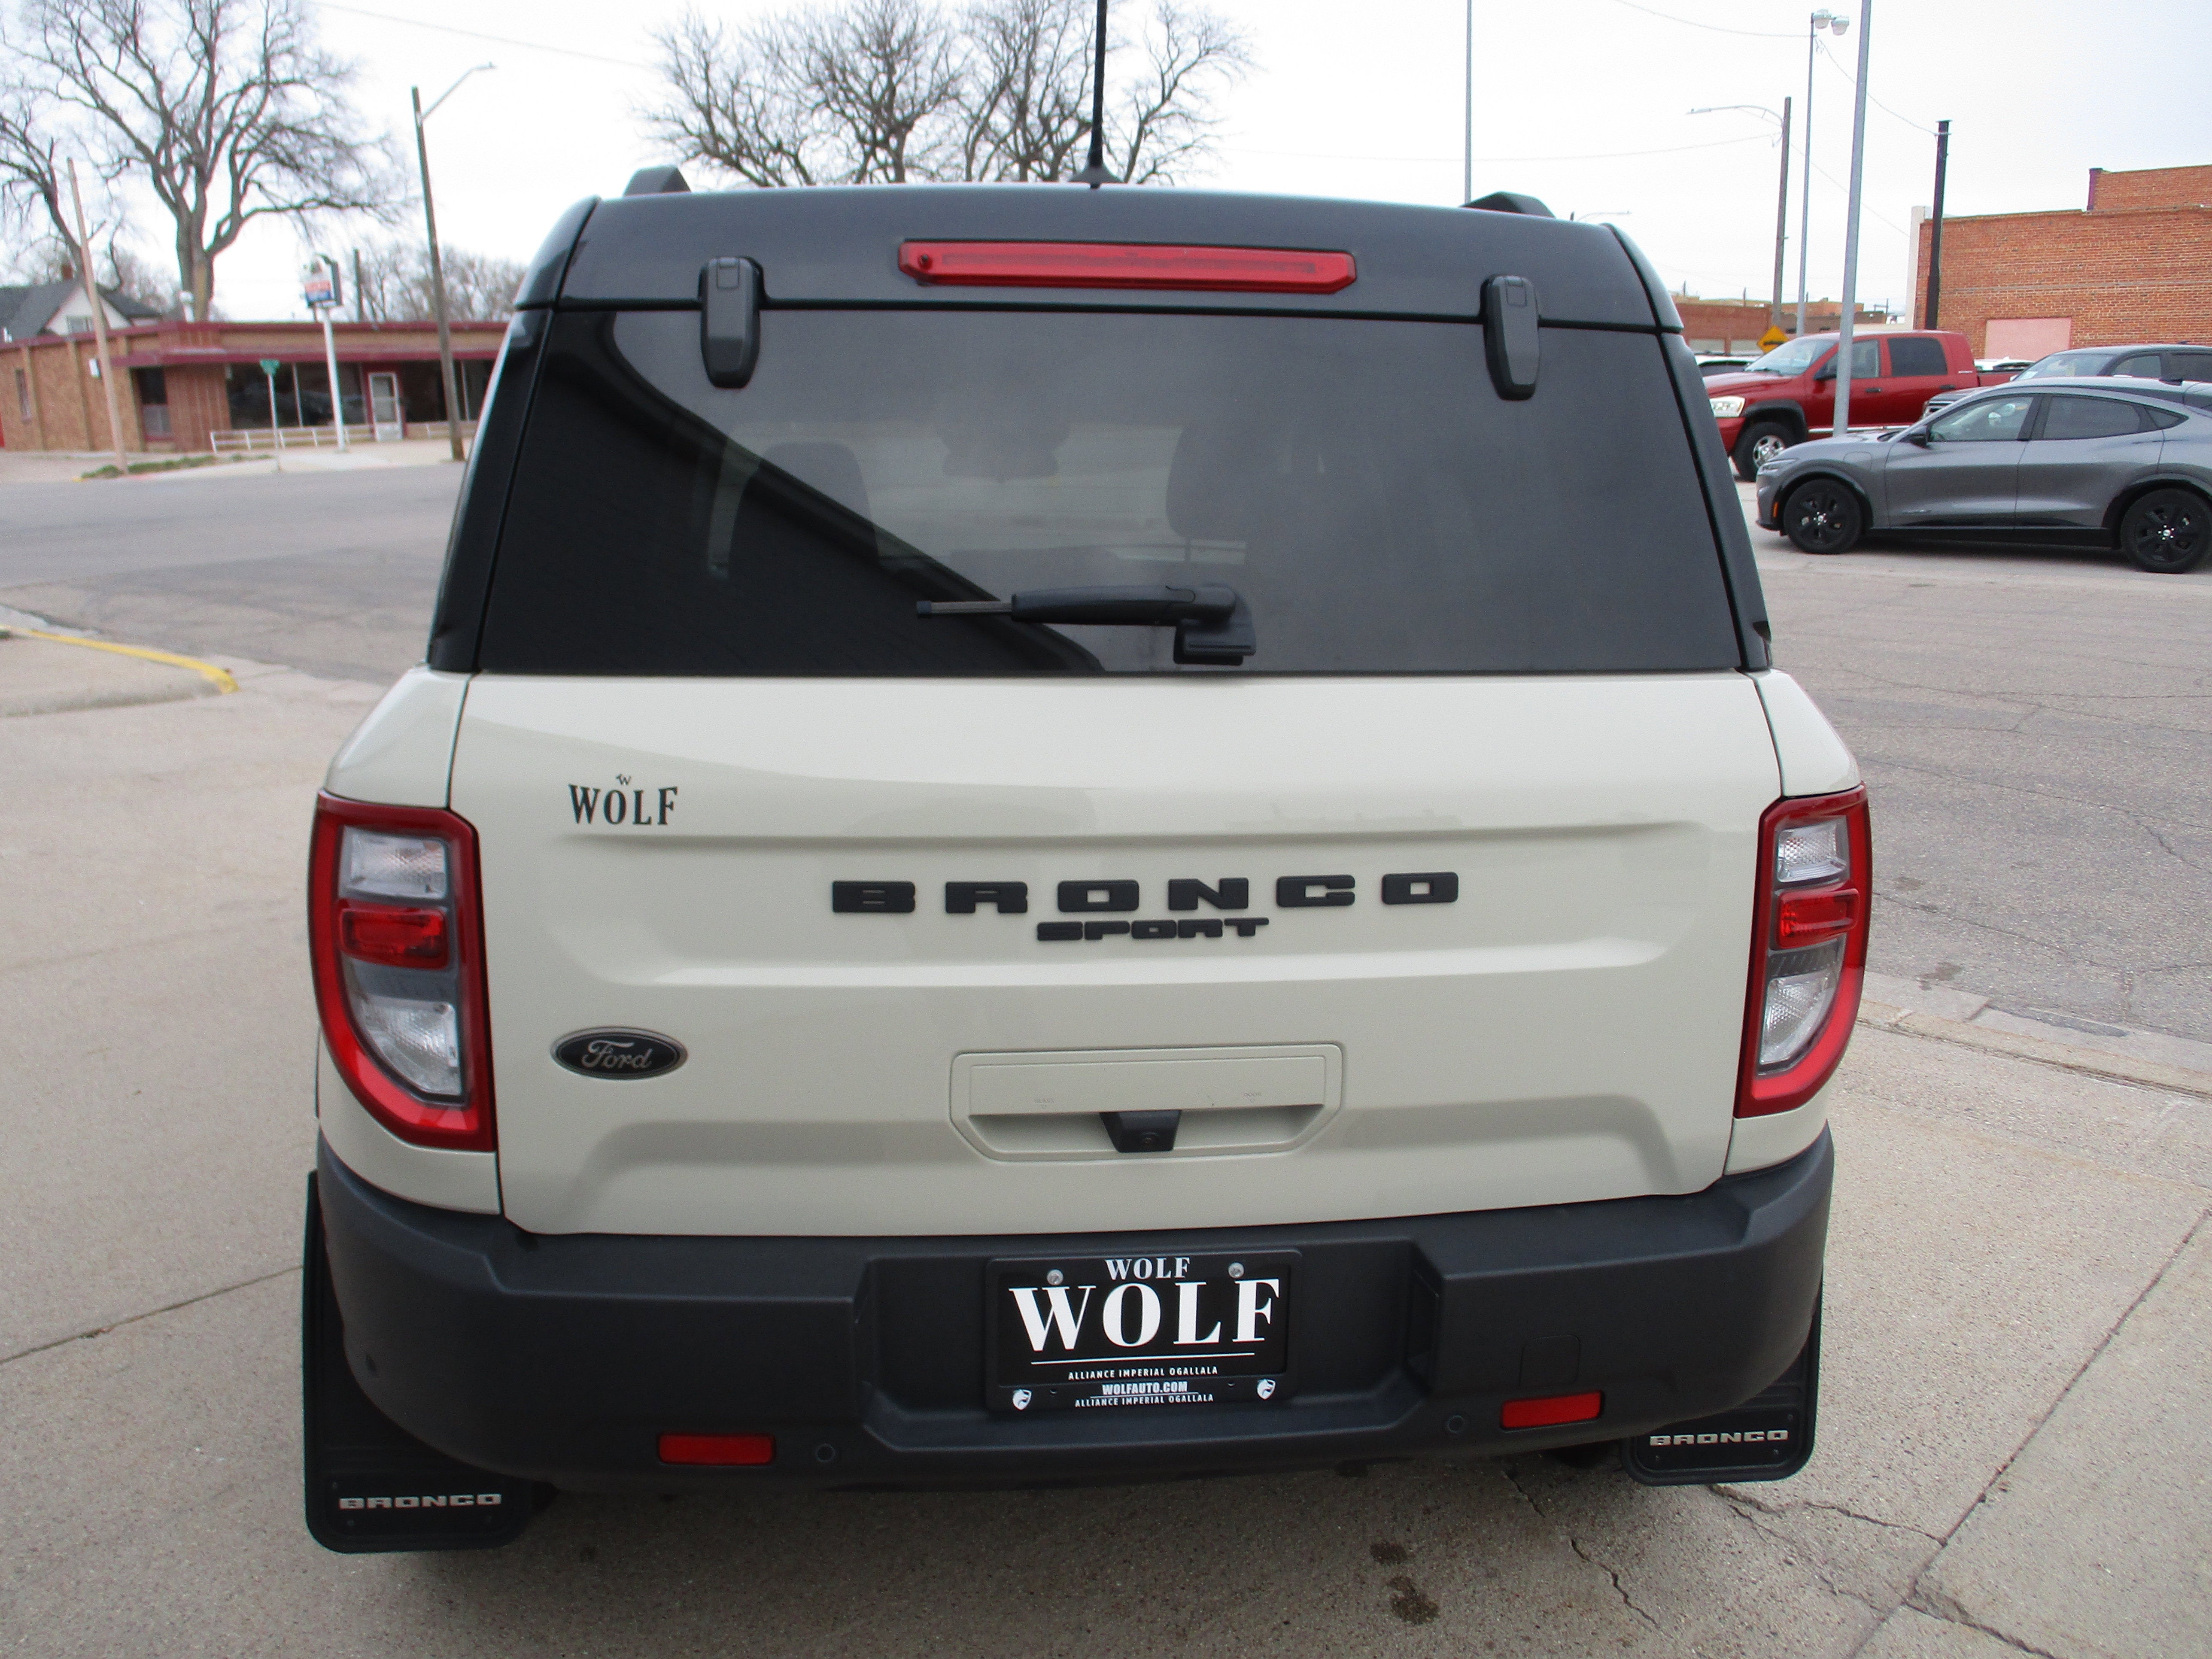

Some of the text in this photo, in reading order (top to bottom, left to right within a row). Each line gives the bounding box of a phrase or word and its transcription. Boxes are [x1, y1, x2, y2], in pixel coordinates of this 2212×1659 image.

[568, 784, 678, 825] WOLF
[832, 872, 1459, 913] BRONCO
[1037, 917, 1269, 941] SPORT
[581, 1039, 653, 1069] Ford
[1104, 1257, 1191, 1280] WOLF
[1009, 1279, 1280, 1352] WOLF
[1068, 1366, 1218, 1381] ALLIANCE IMPERIAL OGALLALA
[1101, 1380, 1188, 1396] WOLFAUTO.COM
[1074, 1394, 1214, 1408] ALLIANCE IMPERIAL OGALLALA
[1649, 1429, 1789, 1446] BRONCO
[339, 1493, 502, 1510] BRONCO
